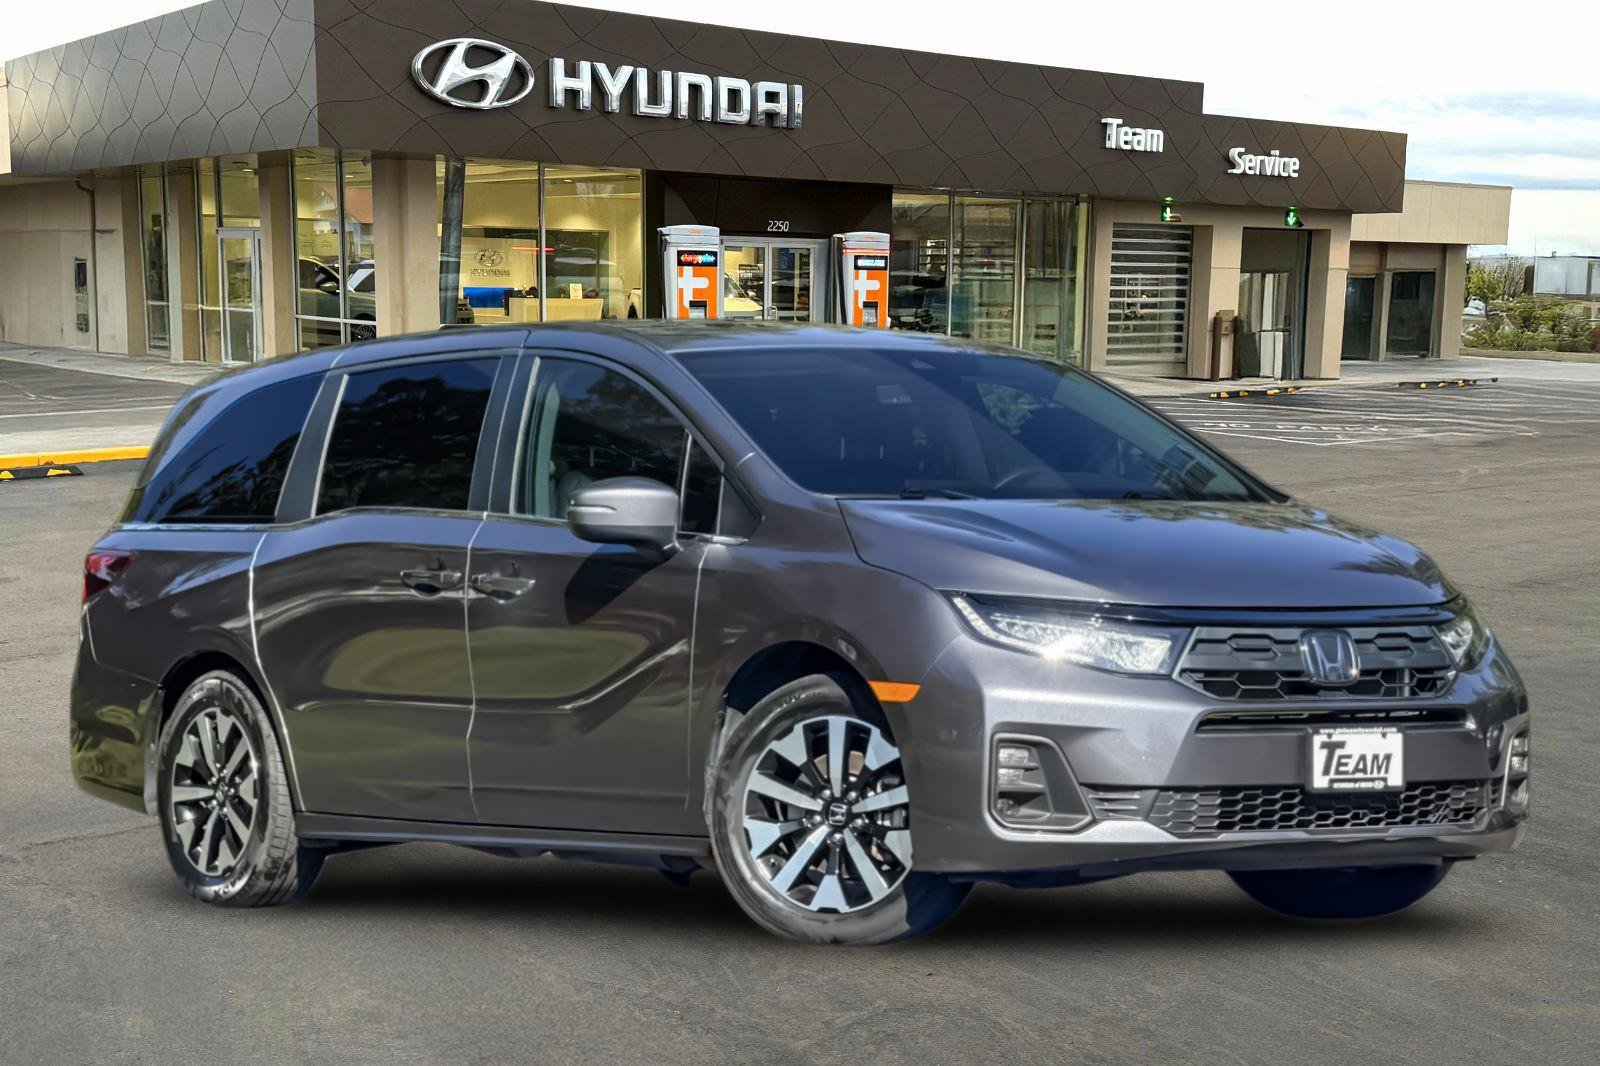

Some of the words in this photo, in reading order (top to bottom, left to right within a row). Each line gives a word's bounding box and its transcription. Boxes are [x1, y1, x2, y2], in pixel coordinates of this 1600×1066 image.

[549, 57, 803, 129] HYUNDAI
[1102, 118, 1164, 152] Team
[1228, 147, 1300, 177] Service
[767, 220, 790, 232] 2250
[1319, 740, 1393, 777] TEAM
